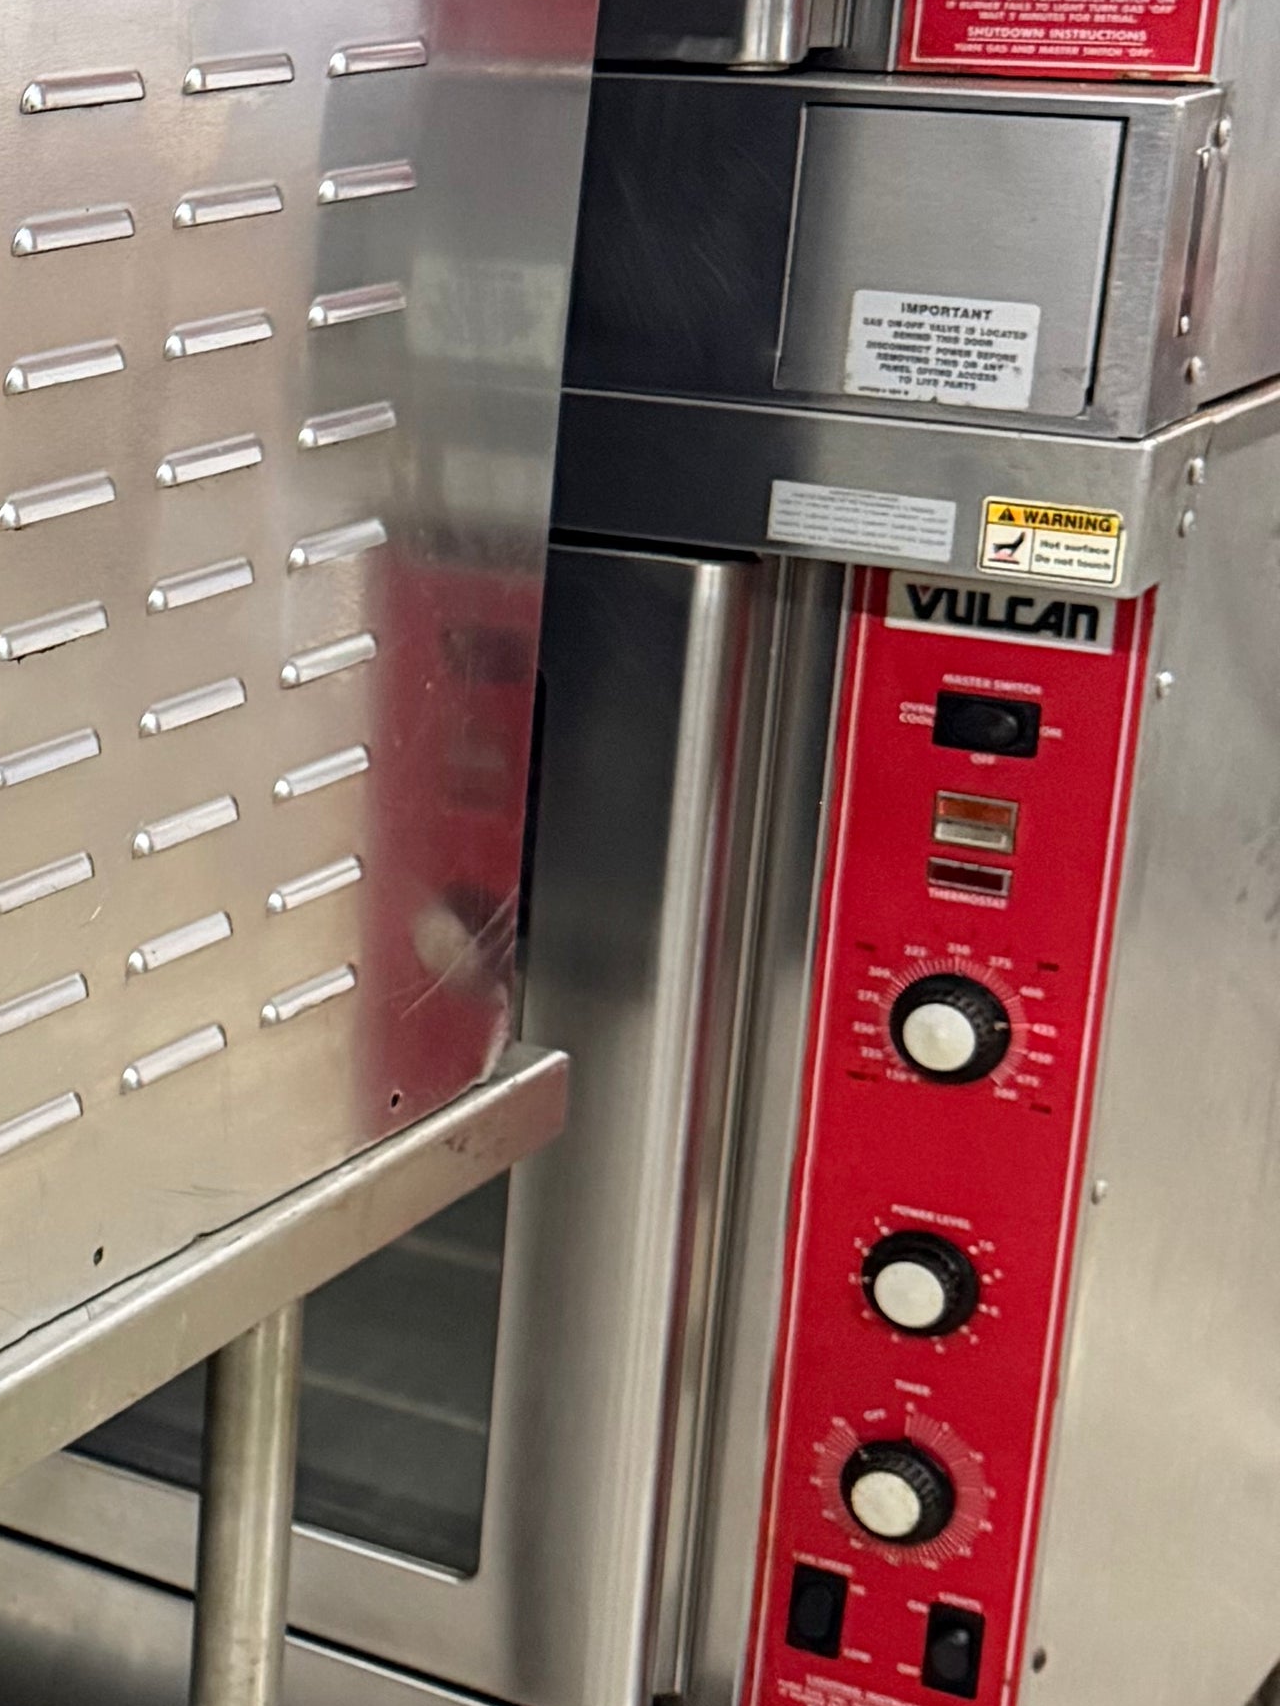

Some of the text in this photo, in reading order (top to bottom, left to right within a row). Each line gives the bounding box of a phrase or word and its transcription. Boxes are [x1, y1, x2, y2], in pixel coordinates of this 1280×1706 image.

[967, 26, 1147, 41] SHUTDOWN INSTRUCTIONS
[901, 302, 992, 321] IMPORTANT
[929, 323, 961, 335] VALVE
[980, 328, 1028, 341] LOCATED
[936, 334, 959, 345] THIS
[936, 346, 972, 358] POWER
[976, 350, 1019, 363] BEFORE
[957, 370, 997, 383] ACCESS
[1023, 509, 1112, 533] WARNING
[1040, 539, 1110, 555] Hot surface
[1035, 553, 1111, 570] Do not touch
[906, 583, 1100, 642] VULCAN
